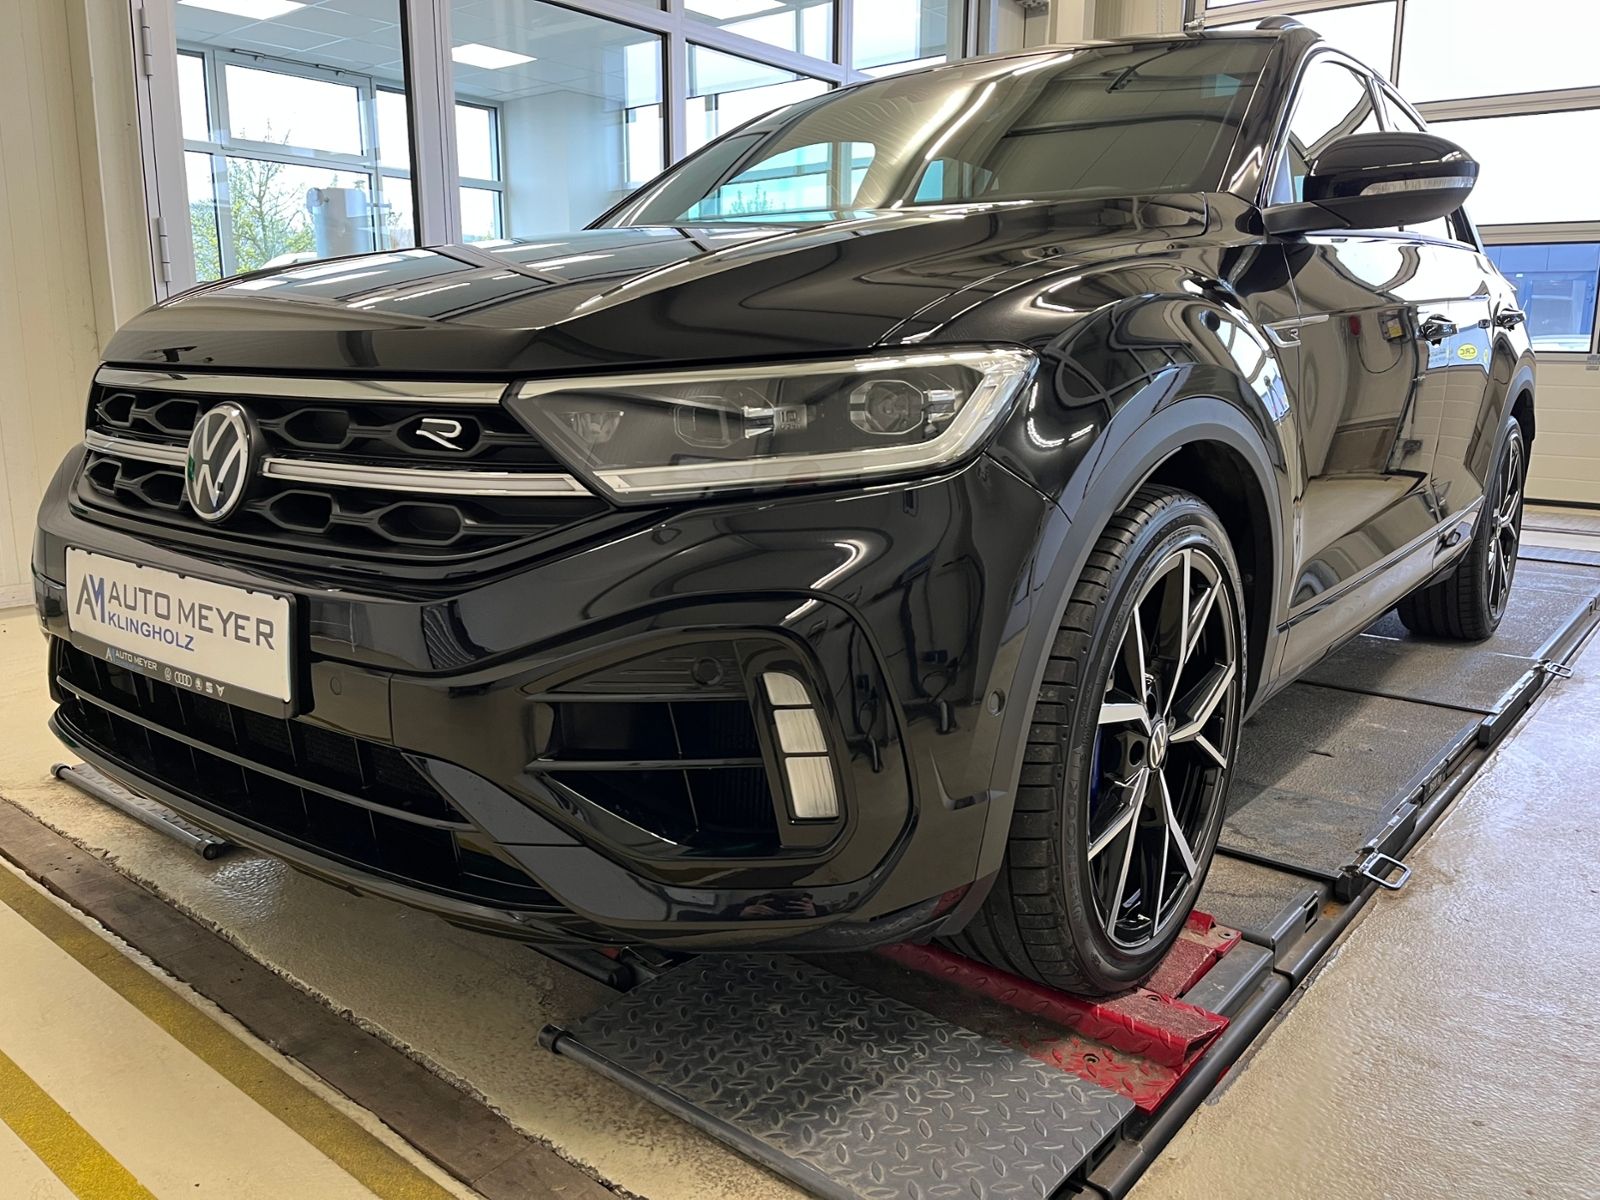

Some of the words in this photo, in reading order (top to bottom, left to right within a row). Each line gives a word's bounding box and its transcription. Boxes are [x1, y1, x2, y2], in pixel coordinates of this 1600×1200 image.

[416, 417, 463, 451] R
[108, 581, 171, 621] AUTO
[178, 598, 275, 650] MEYER
[108, 611, 195, 651] KLINGHOLZ
[115, 650, 133, 662] AUTO
[134, 656, 158, 671] MEYER
